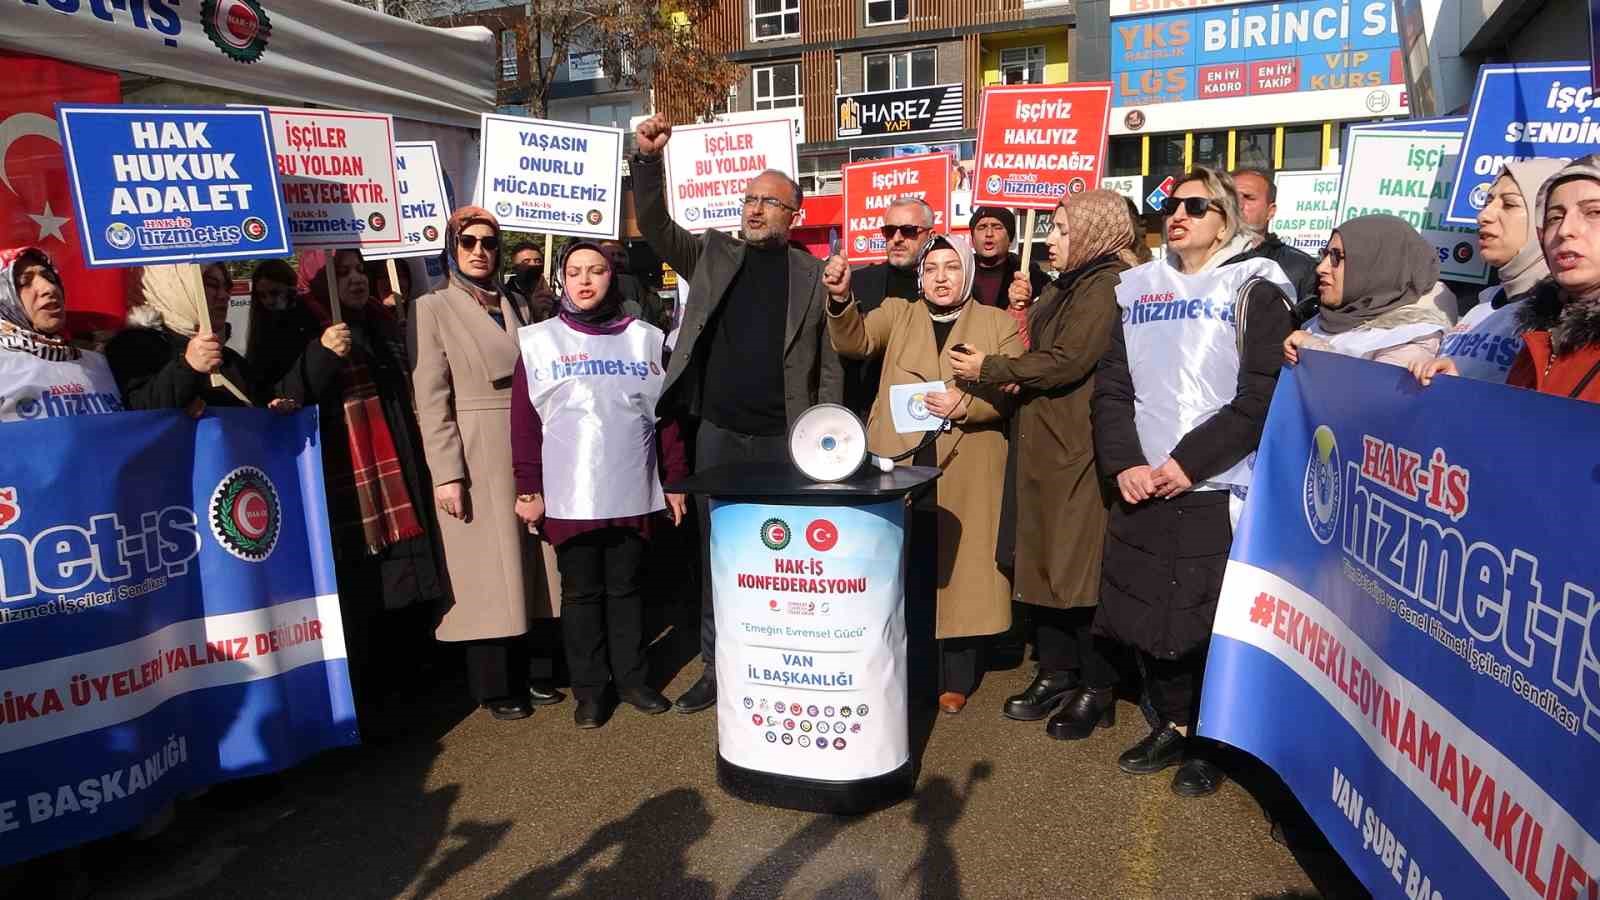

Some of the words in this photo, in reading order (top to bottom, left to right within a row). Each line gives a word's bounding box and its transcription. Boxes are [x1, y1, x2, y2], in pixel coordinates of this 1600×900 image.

[1118, 20, 1190, 49] YKS
[1204, 0, 1350, 51] BİRİNCİ
[1325, 43, 1369, 69] VİP
[1207, 72, 1223, 82] EN
[1225, 68, 1240, 81] İYİ
[1258, 67, 1274, 77] EN
[1258, 76, 1292, 89] TAKİP
[1310, 71, 1383, 89] KURS
[1203, 82, 1242, 93] KADRO
[862, 98, 931, 123] HAREZ
[1015, 98, 1073, 121] İŞÇİYİZ
[131, 121, 211, 150] HAK
[285, 120, 347, 150] İŞÇİLER
[519, 131, 588, 154] YAŞASIN
[704, 133, 753, 154] İŞÇİLER
[1004, 128, 1079, 146] HAKLIYIZ
[299, 155, 364, 177] YOLDAN
[519, 156, 584, 176] ONURLU
[695, 161, 716, 177] BU
[716, 154, 767, 174] YOLDAN
[983, 152, 1096, 172] KAZANACAĞIZ
[1407, 144, 1445, 168] İŞÇİ
[112, 153, 240, 183] HUKUK
[872, 168, 920, 189] İŞÇİYİZ
[111, 184, 253, 215] ADALET
[493, 178, 607, 203] MÜCADELEMİZ
[1296, 200, 1339, 212] HAKLA
[1361, 436, 1469, 521] HAK-İŞ
[774, 557, 824, 576] HAK-İŞ
[737, 573, 867, 594] KONFEDERASYONU
[785, 626, 831, 639] Evrensel
[70, 650, 164, 707] ÜYELERİ
[165, 636, 250, 672] YALNIZ
[782, 653, 814, 668] VAN
[1398, 600, 1428, 630] Genel
[1429, 619, 1467, 660] Hizmet
[1468, 638, 1510, 688] İşçileri
[1512, 670, 1580, 736] Sendikası
[748, 664, 761, 680] İL
[763, 668, 853, 687] BAŞKANLIĞI
[28, 732, 188, 825] BAŞKANLIĞI
[1331, 766, 1364, 829] VAN
[1363, 808, 1408, 885] ŞUBE
[1404, 858, 1444, 900] BA
